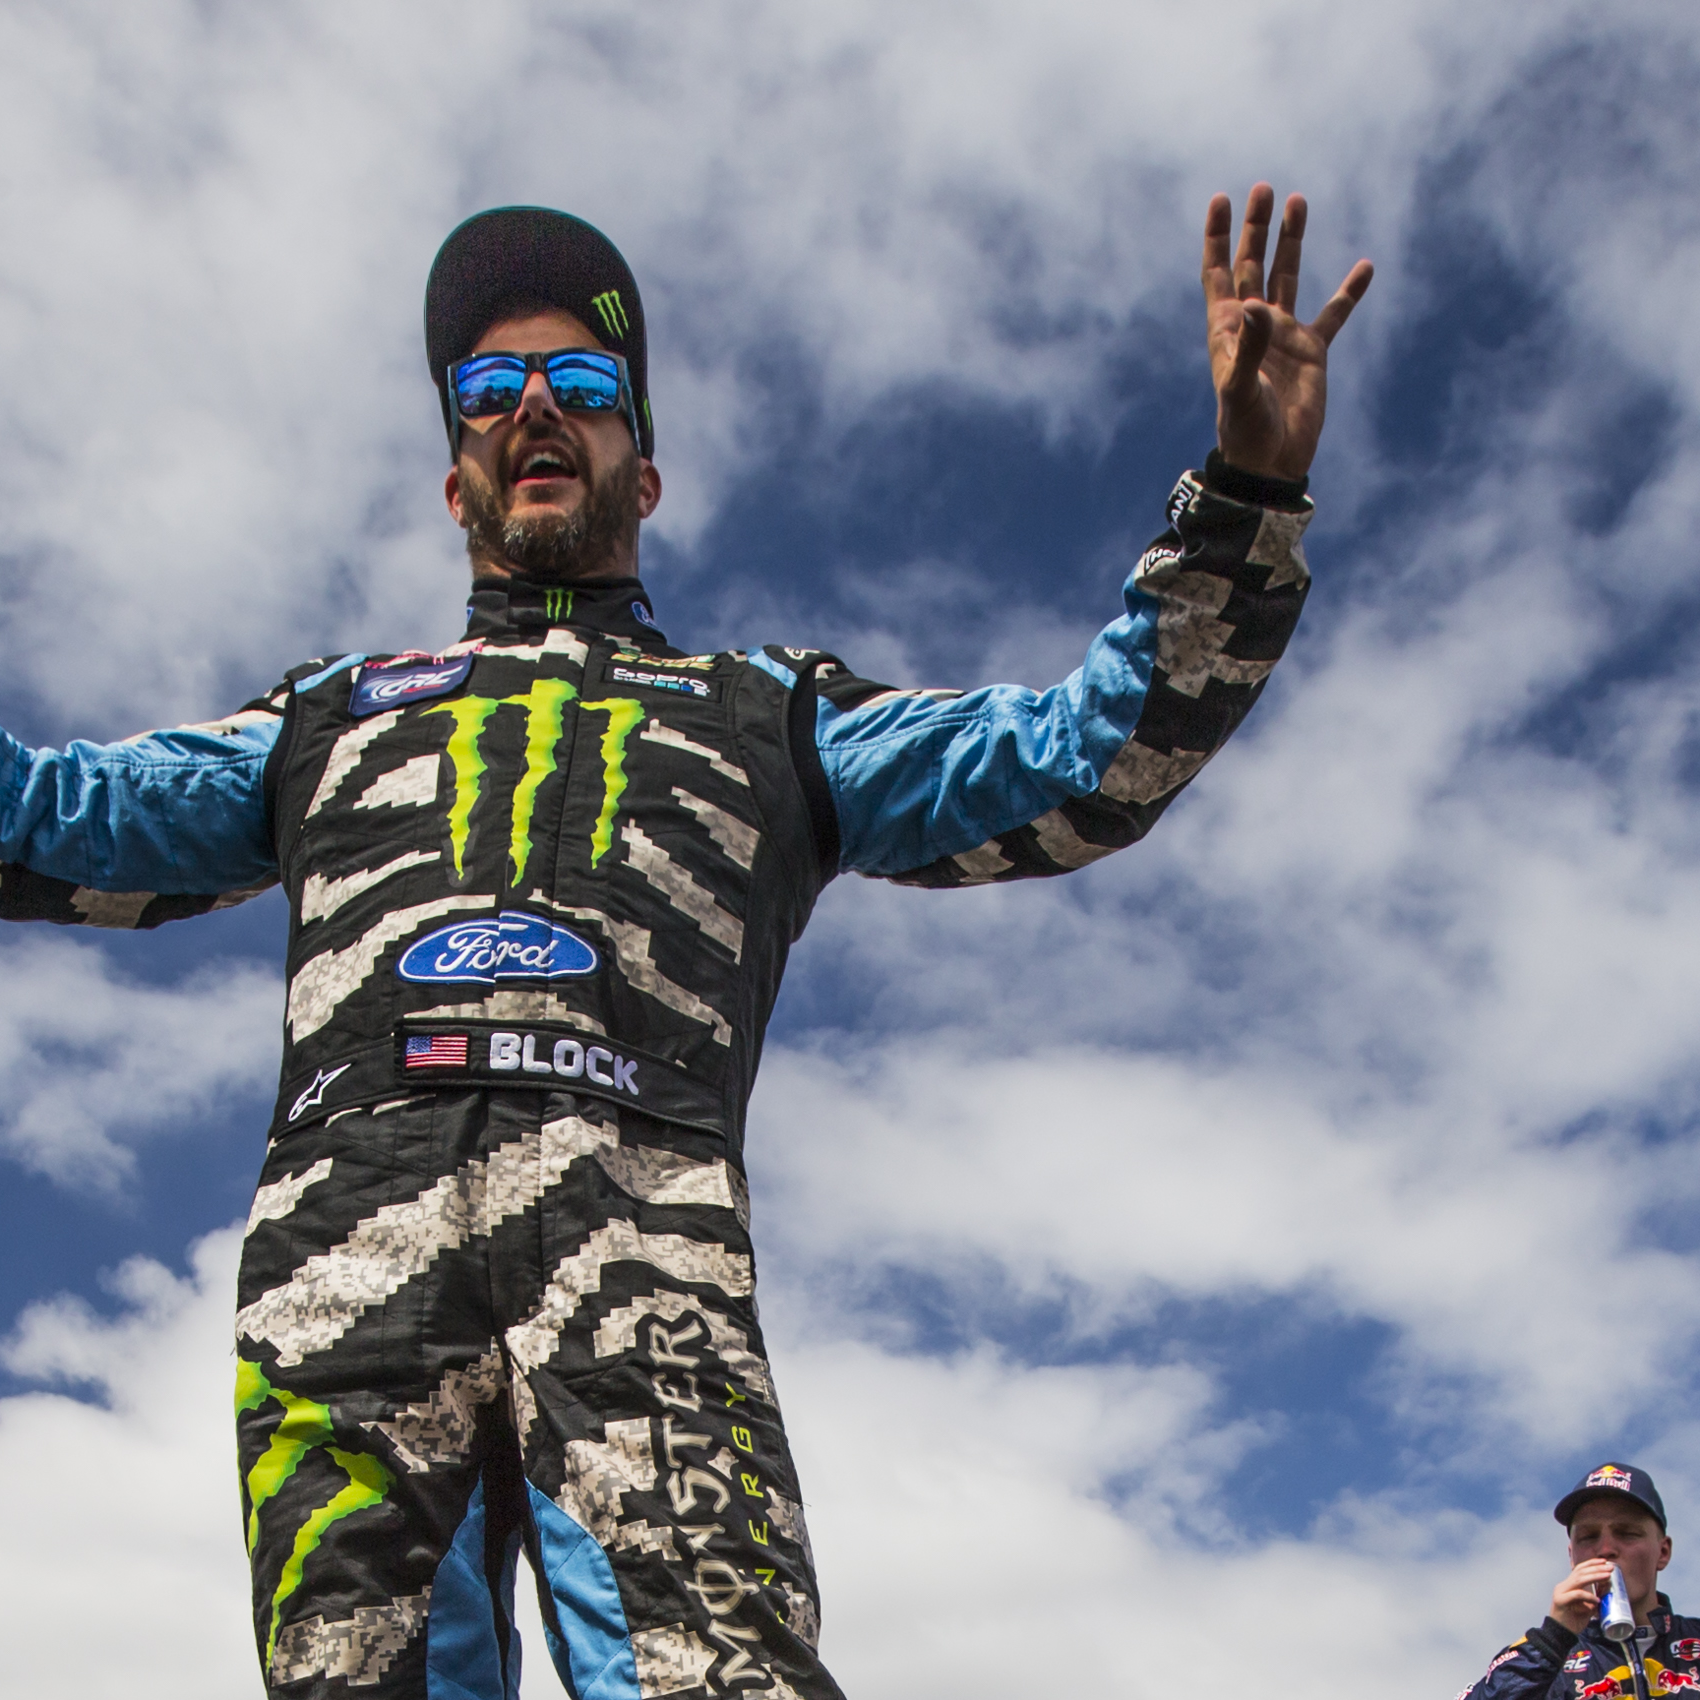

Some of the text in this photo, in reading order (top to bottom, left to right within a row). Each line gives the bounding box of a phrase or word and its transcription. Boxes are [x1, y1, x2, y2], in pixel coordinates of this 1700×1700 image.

[614, 667, 708, 691] GoPro
[434, 923, 557, 974] Ford
[490, 1032, 639, 1095] BLOCK
[1564, 1655, 1591, 1670] RC
